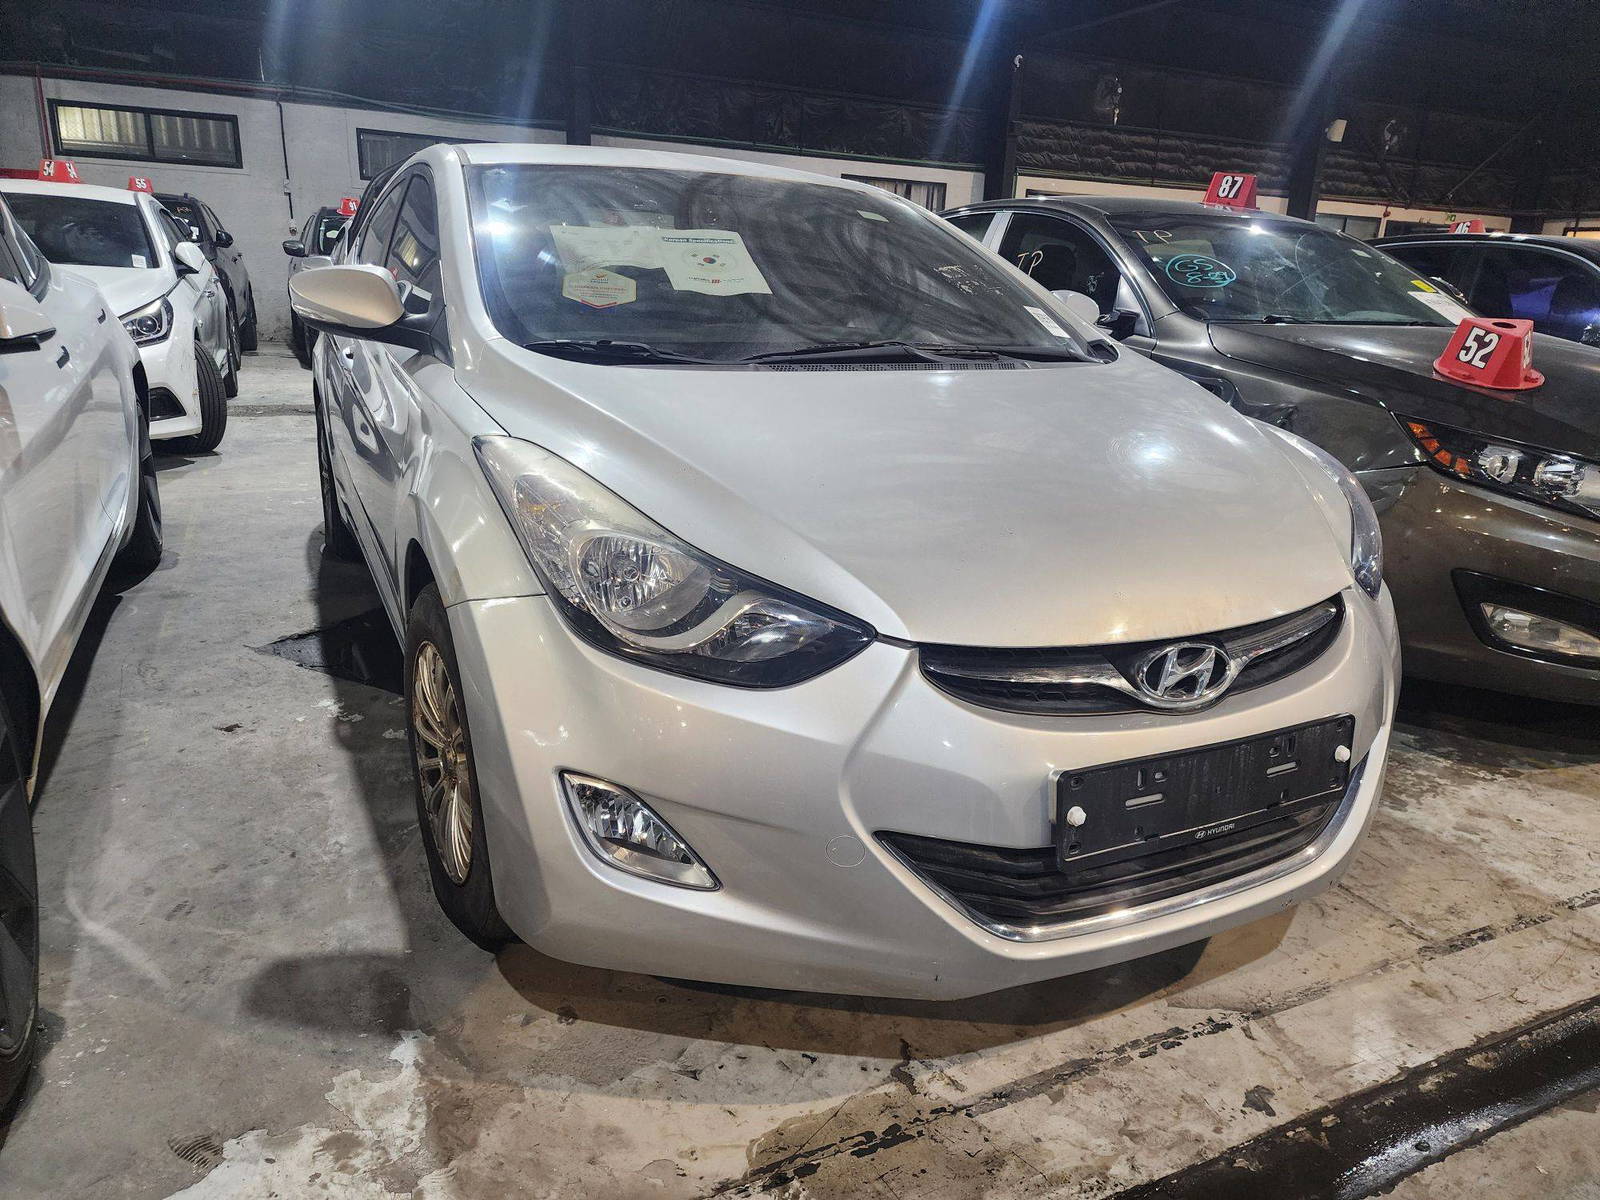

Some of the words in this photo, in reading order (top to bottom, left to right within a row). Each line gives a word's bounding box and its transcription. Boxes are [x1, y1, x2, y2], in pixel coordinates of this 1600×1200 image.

[43, 161, 55, 176] 54
[135, 178, 147, 189] 55
[1219, 175, 1244, 198] 87
[1458, 327, 1500, 369] 52
[1207, 823, 1235, 836] HYUNDAI
